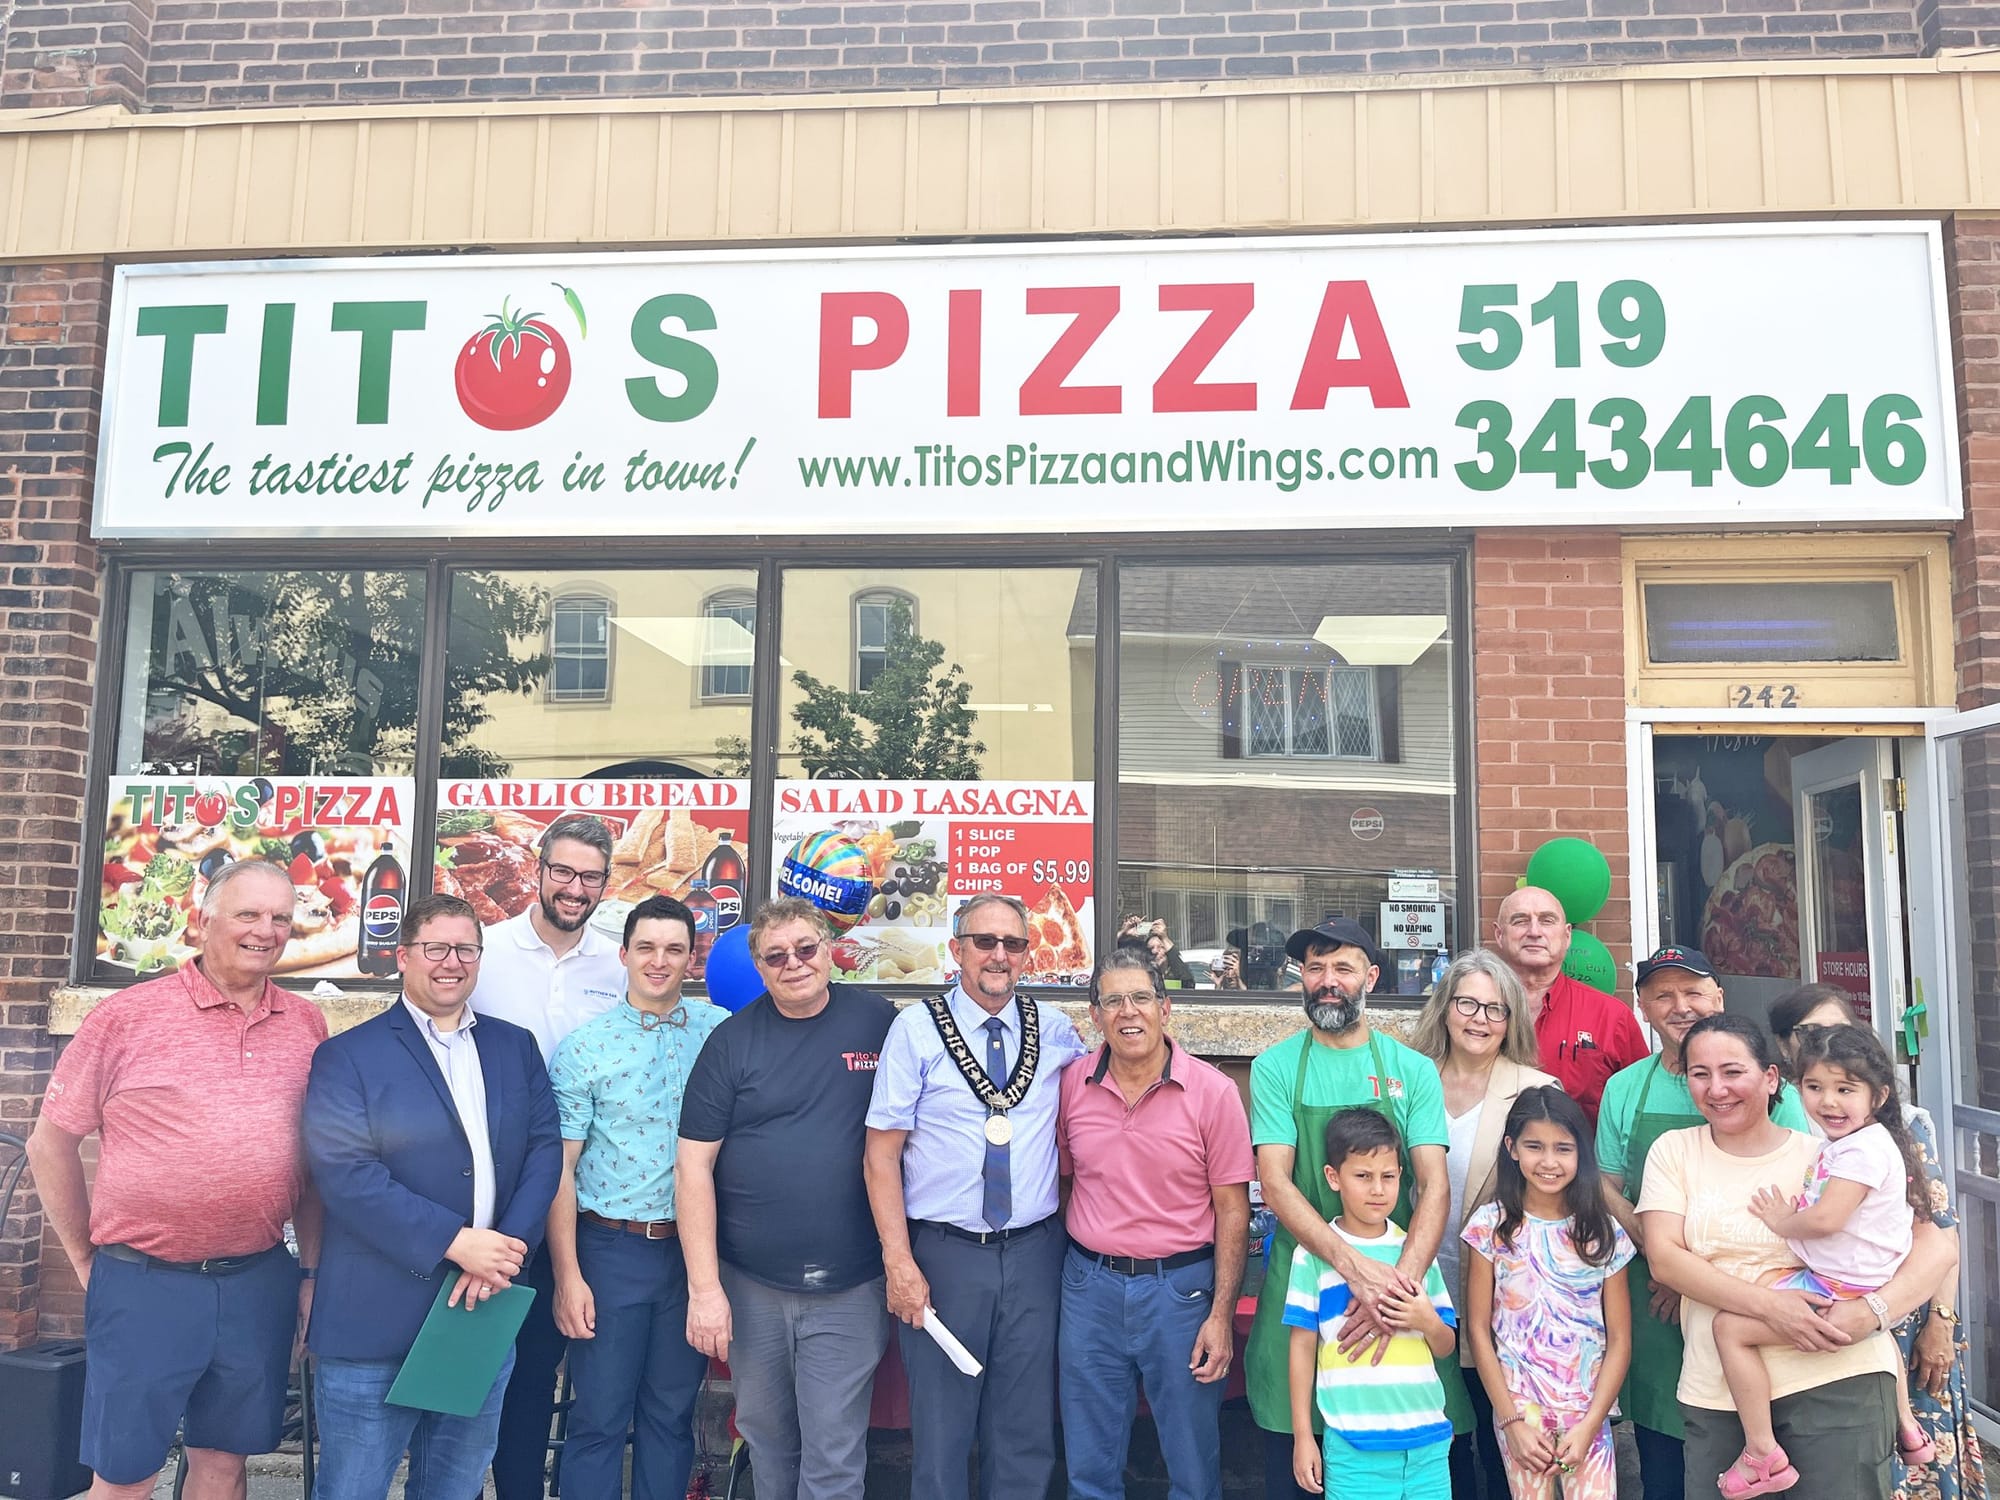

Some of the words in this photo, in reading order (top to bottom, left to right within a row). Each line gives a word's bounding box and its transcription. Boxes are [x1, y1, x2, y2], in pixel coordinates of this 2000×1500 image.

[1456, 279, 1666, 371] 519
[817, 279, 1411, 419] PIZZA
[1454, 393, 1927, 491] 3434646
[153, 441, 230, 499] The
[248, 450, 414, 495] tastiest
[422, 452, 544, 512] pizza
[562, 450, 605, 493] in
[624, 437, 757, 491] town!
[798, 438, 1439, 493] www.TitosPizzaandWings.com
[1192, 665, 1333, 708] OPEN
[1737, 685, 1797, 708] 242
[275, 786, 401, 825] PIZZA
[447, 783, 597, 807] GARLIC
[603, 783, 738, 807] BREAD
[780, 788, 904, 813] SALAD
[912, 789, 1089, 816] LASAGNA
[955, 829, 963, 840] 1
[968, 829, 1016, 841] SLICE
[1351, 820, 1382, 828] PEPSI
[955, 845, 963, 857] 1
[968, 845, 1001, 858] POP
[954, 861, 963, 874] 1
[968, 862, 1002, 875] BAG
[1006, 862, 1028, 874] OF
[1032, 858, 1091, 884] $5.99
[780, 865, 843, 903] ELCOME!
[953, 878, 1003, 891] CHIPS
[365, 911, 400, 920] PEPSI
[717, 901, 741, 912] PSI
[1389, 904, 1400, 913] NO
[1401, 904, 1436, 913] SMOKING
[1393, 924, 1404, 933] NO
[1405, 924, 1433, 933] VAPING
[1822, 962, 1844, 976] STORE
[1844, 962, 1868, 977] HOURS
